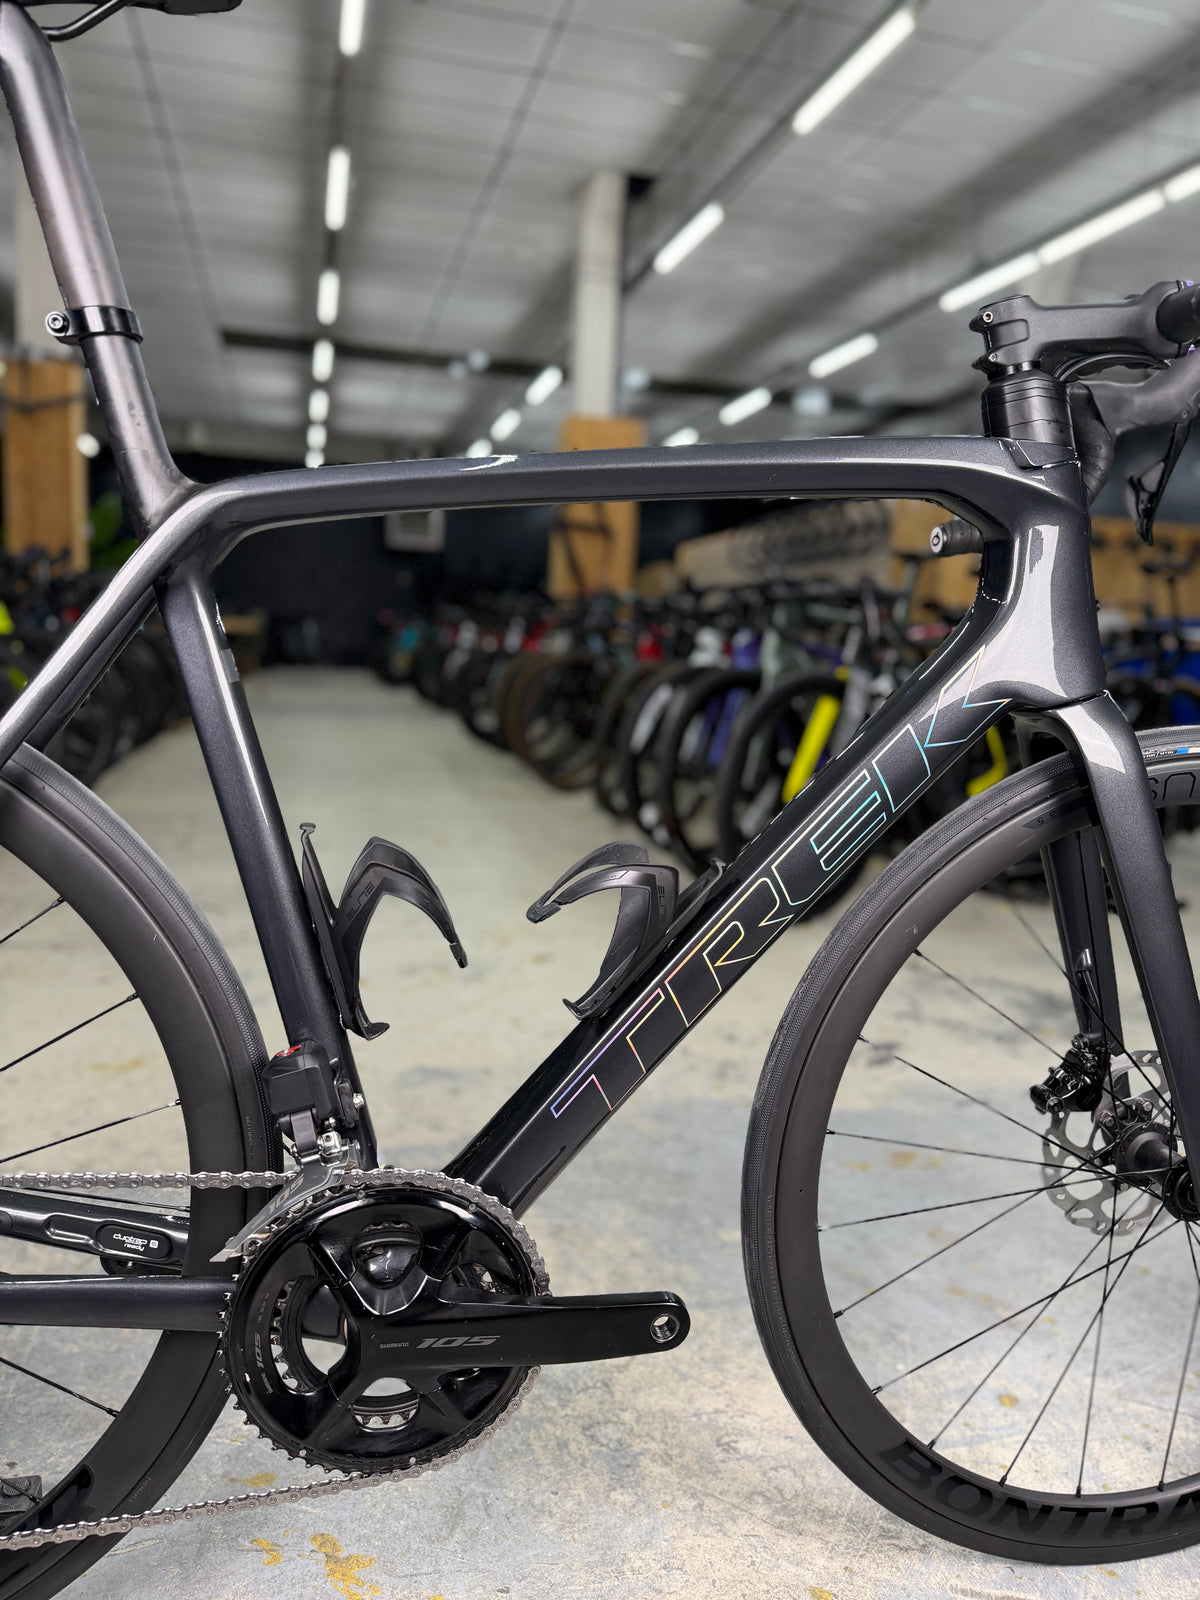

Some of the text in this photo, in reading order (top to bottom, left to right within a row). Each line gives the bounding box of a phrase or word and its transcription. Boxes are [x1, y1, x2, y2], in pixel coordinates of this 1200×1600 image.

[550, 644, 1012, 1118] TREK
[268, 1173, 304, 1215] 105
[416, 1335, 501, 1349] 105
